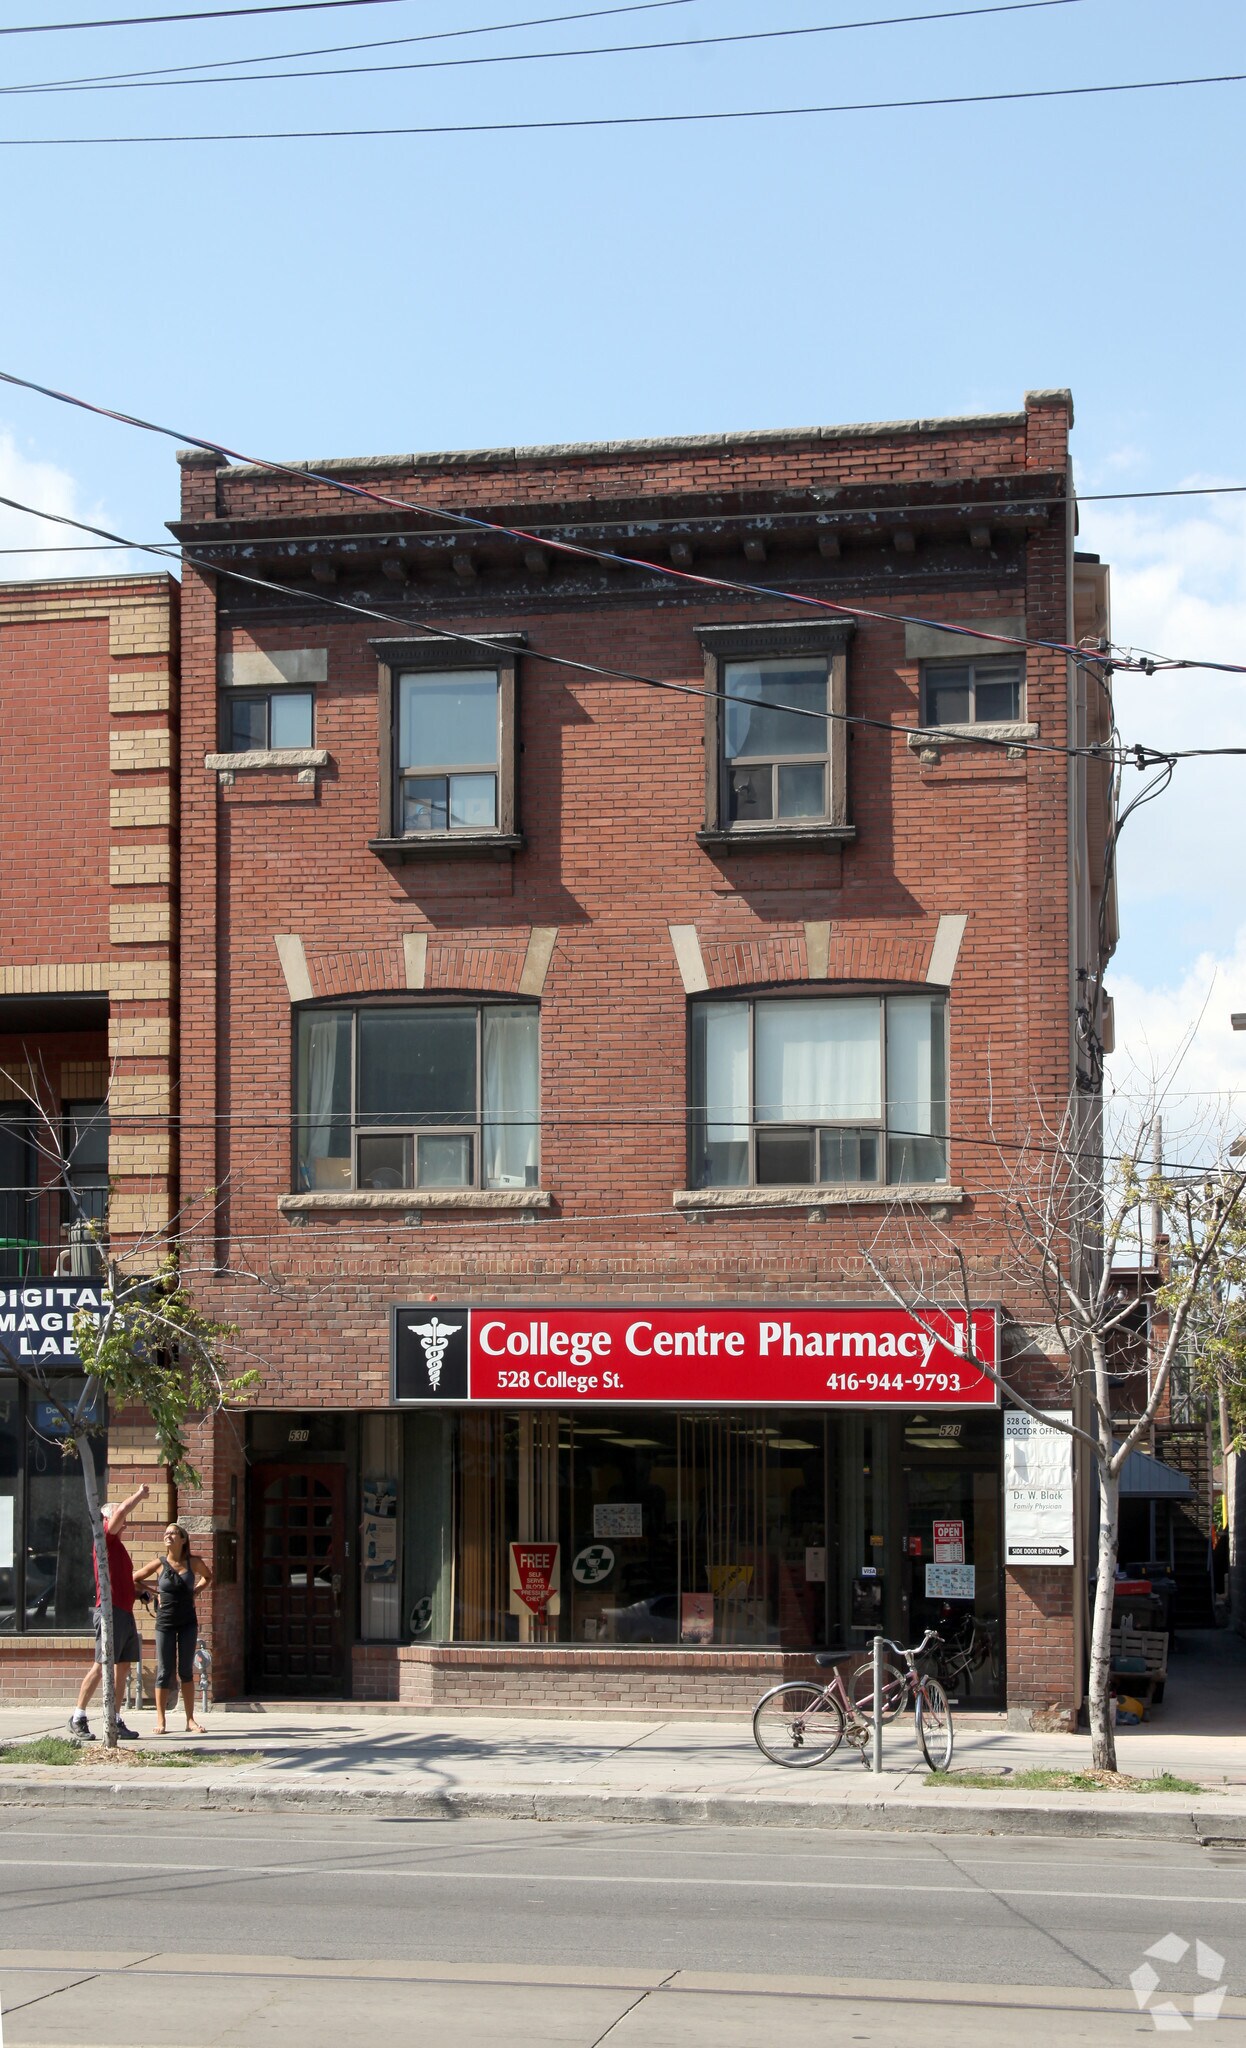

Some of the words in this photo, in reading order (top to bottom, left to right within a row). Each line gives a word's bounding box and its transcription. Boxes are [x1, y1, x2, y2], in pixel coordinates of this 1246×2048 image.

[479, 1321, 612, 1366] College
[625, 1321, 745, 1357] Centre
[759, 1321, 937, 1368] Pharmacy
[497, 1370, 530, 1388] 528
[533, 1370, 598, 1393] College
[602, 1371, 624, 1389] St.
[826, 1372, 961, 1391] 416-944-9793
[1006, 1417, 1020, 1425] 528
[1022, 1417, 1047, 1426] Colleg
[289, 1431, 308, 1440] 530
[940, 1425, 960, 1436] 528
[1006, 1427, 1038, 1435] DOCTOR
[1013, 1491, 1025, 1500] Dr.
[1028, 1491, 1038, 1500] W.
[1041, 1490, 1063, 1500] Black
[1013, 1503, 1034, 1511] Family
[1035, 1503, 1062, 1511] Physician
[938, 1527, 960, 1537] OPEN
[520, 1553, 550, 1568] FREE
